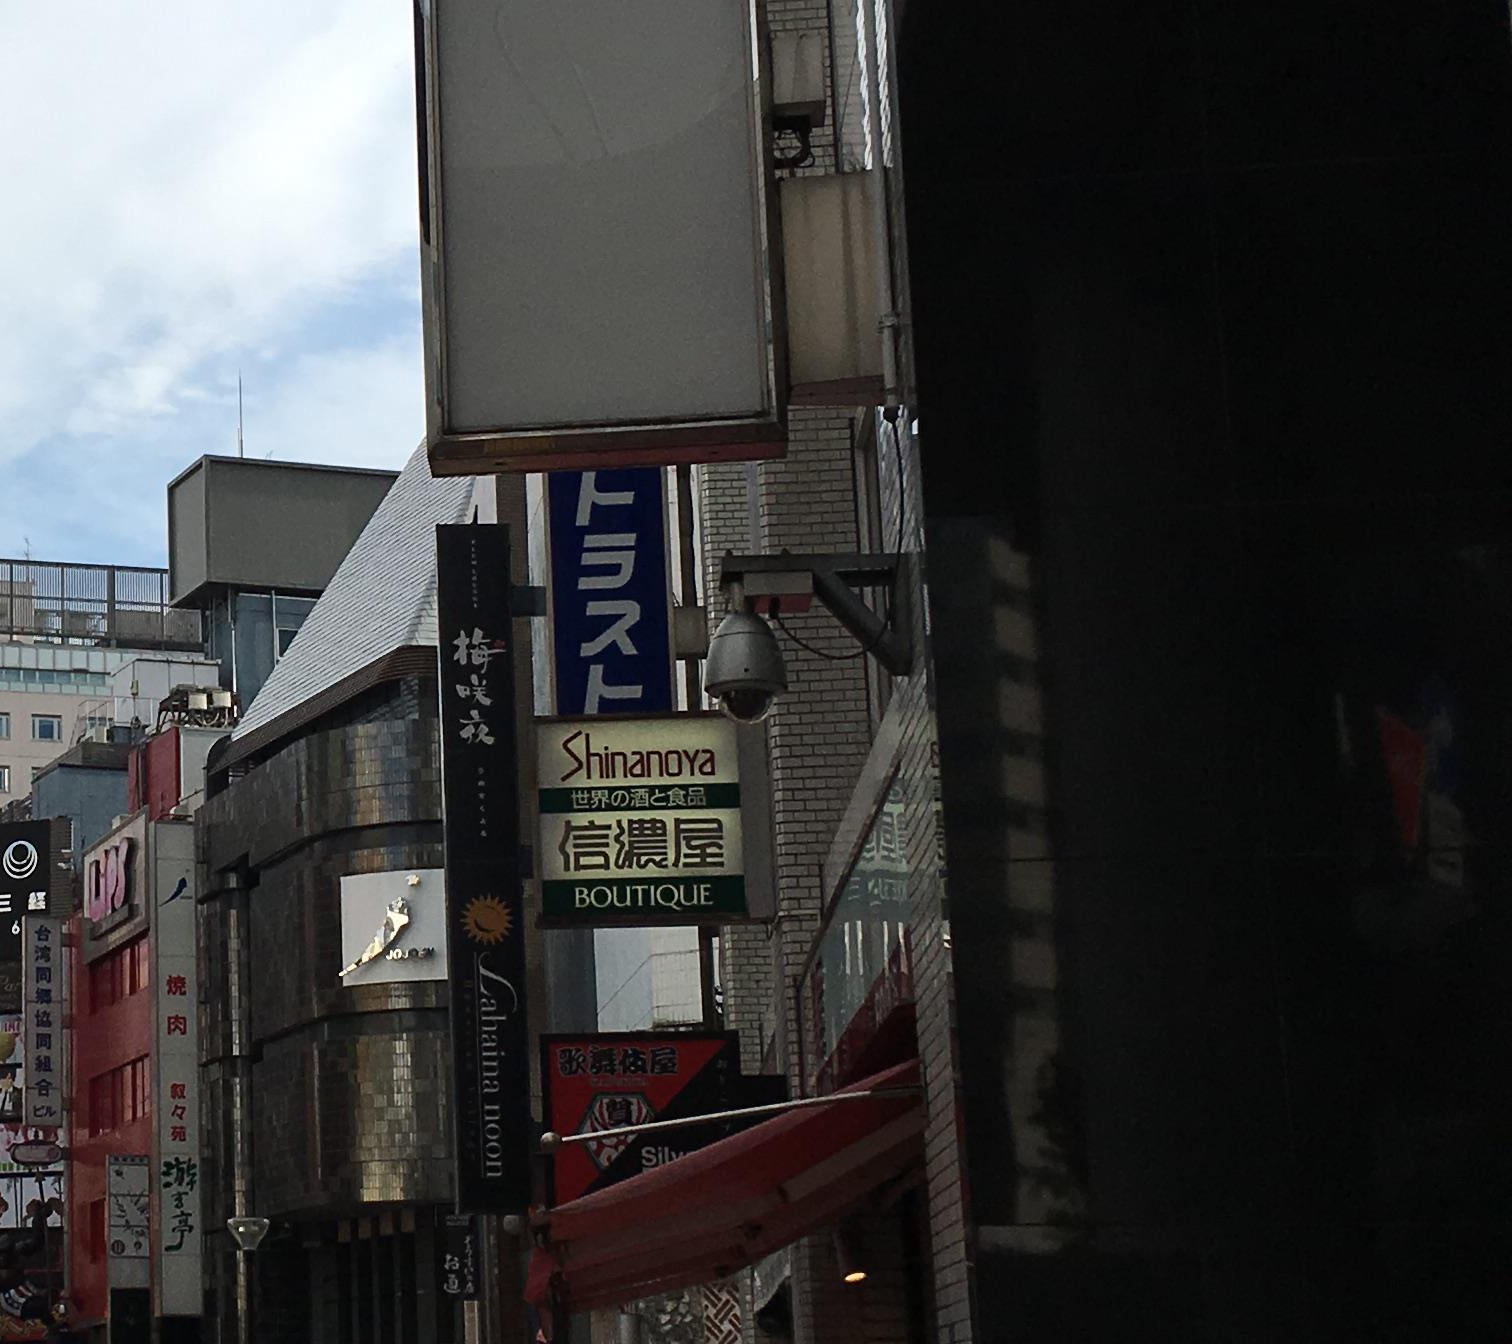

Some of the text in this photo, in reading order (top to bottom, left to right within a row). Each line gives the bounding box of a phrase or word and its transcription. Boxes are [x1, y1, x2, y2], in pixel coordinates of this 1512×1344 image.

[561, 731, 716, 781] Shinanoya
[570, 787, 707, 809] 世界の酒と食品
[558, 816, 725, 872] 信濃屋
[575, 885, 714, 911] BOUTIQUE
[167, 975, 187, 1036] 焼肉
[479, 951, 517, 1178] Lahaina noon
[170, 1083, 187, 1142] 叙々苑
[641, 1146, 691, 1167] Silv
